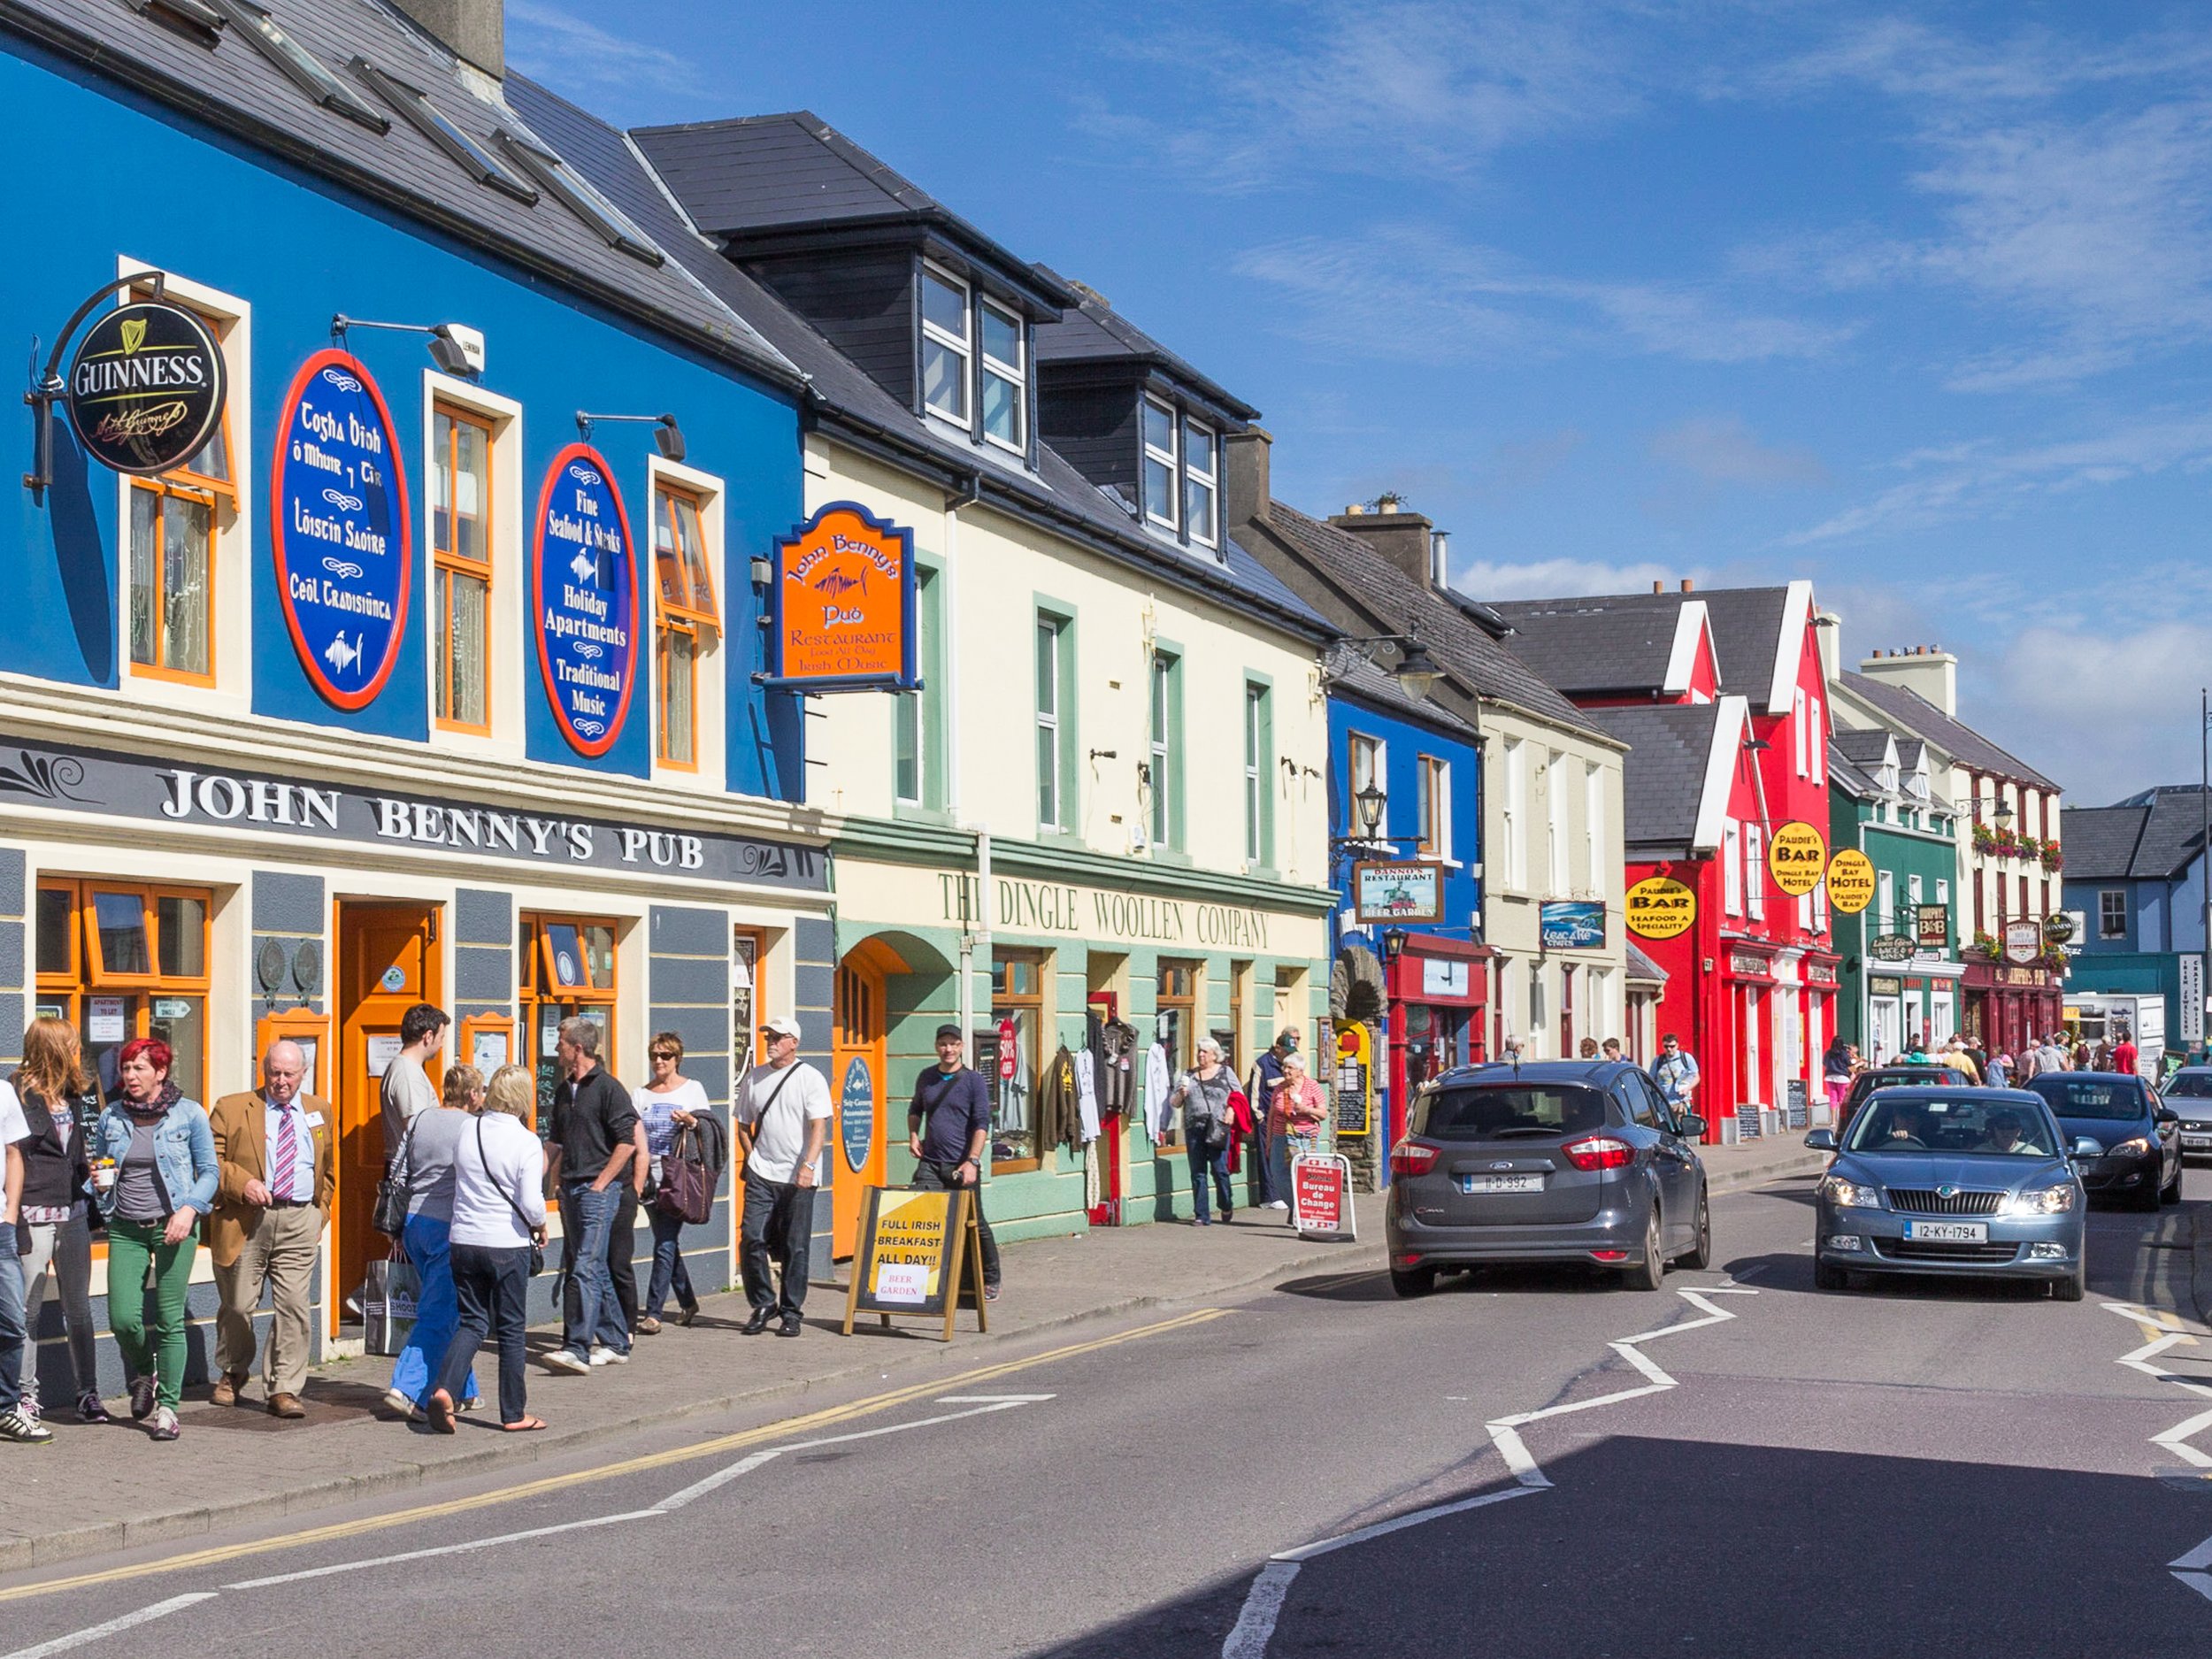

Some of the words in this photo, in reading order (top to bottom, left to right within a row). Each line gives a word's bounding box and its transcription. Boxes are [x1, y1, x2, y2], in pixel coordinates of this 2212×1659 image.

[75, 356, 204, 396] GUINNESS
[576, 489, 598, 517] Fine
[549, 510, 583, 543] Seafood
[584, 521, 593, 546] &
[595, 523, 620, 554] Steaks
[787, 545, 829, 586] John
[831, 534, 899, 580] Benny's
[564, 584, 608, 622] Holiday
[822, 605, 864, 629] Pub
[544, 608, 626, 647] Apartments
[557, 658, 620, 691] Traditional
[572, 689, 605, 717] Music
[161, 768, 342, 831] JOHN
[377, 796, 594, 861] BENNY'S
[621, 827, 704, 871] PUB
[1779, 834, 1817, 844] PAUDIE'S
[1777, 847, 1820, 862] BAR
[1364, 873, 1432, 882] RESTAURANT
[1783, 878, 1812, 887] HOTEL
[1831, 877, 1871, 888] HOTEL
[1640, 887, 1681, 895] PAUDIE'S
[1630, 896, 1689, 910] BAR
[938, 872, 980, 923] TH
[999, 879, 1078, 932] DINGLE
[1094, 892, 1184, 942] WOOLLEN
[1197, 904, 1270, 949] COMPANY
[1365, 908, 1390, 917] BEER
[1392, 908, 1432, 918] GARDEN
[1919, 921, 1945, 934] B&B
[1302, 1181, 1335, 1193] Bureau
[1312, 1191, 1324, 1200] de
[1301, 1197, 1335, 1210] Change
[881, 1219, 908, 1230] FULL
[911, 1220, 941, 1231] IRISH
[1919, 1225, 1977, 1239] 12-KY-1794
[877, 1236, 941, 1248] BREAKFAST
[877, 1254, 901, 1264] ALL
[904, 1254, 936, 1265] DAY!!
[888, 1274, 912, 1284] BEER
[880, 1286, 918, 1296] GARDEN
